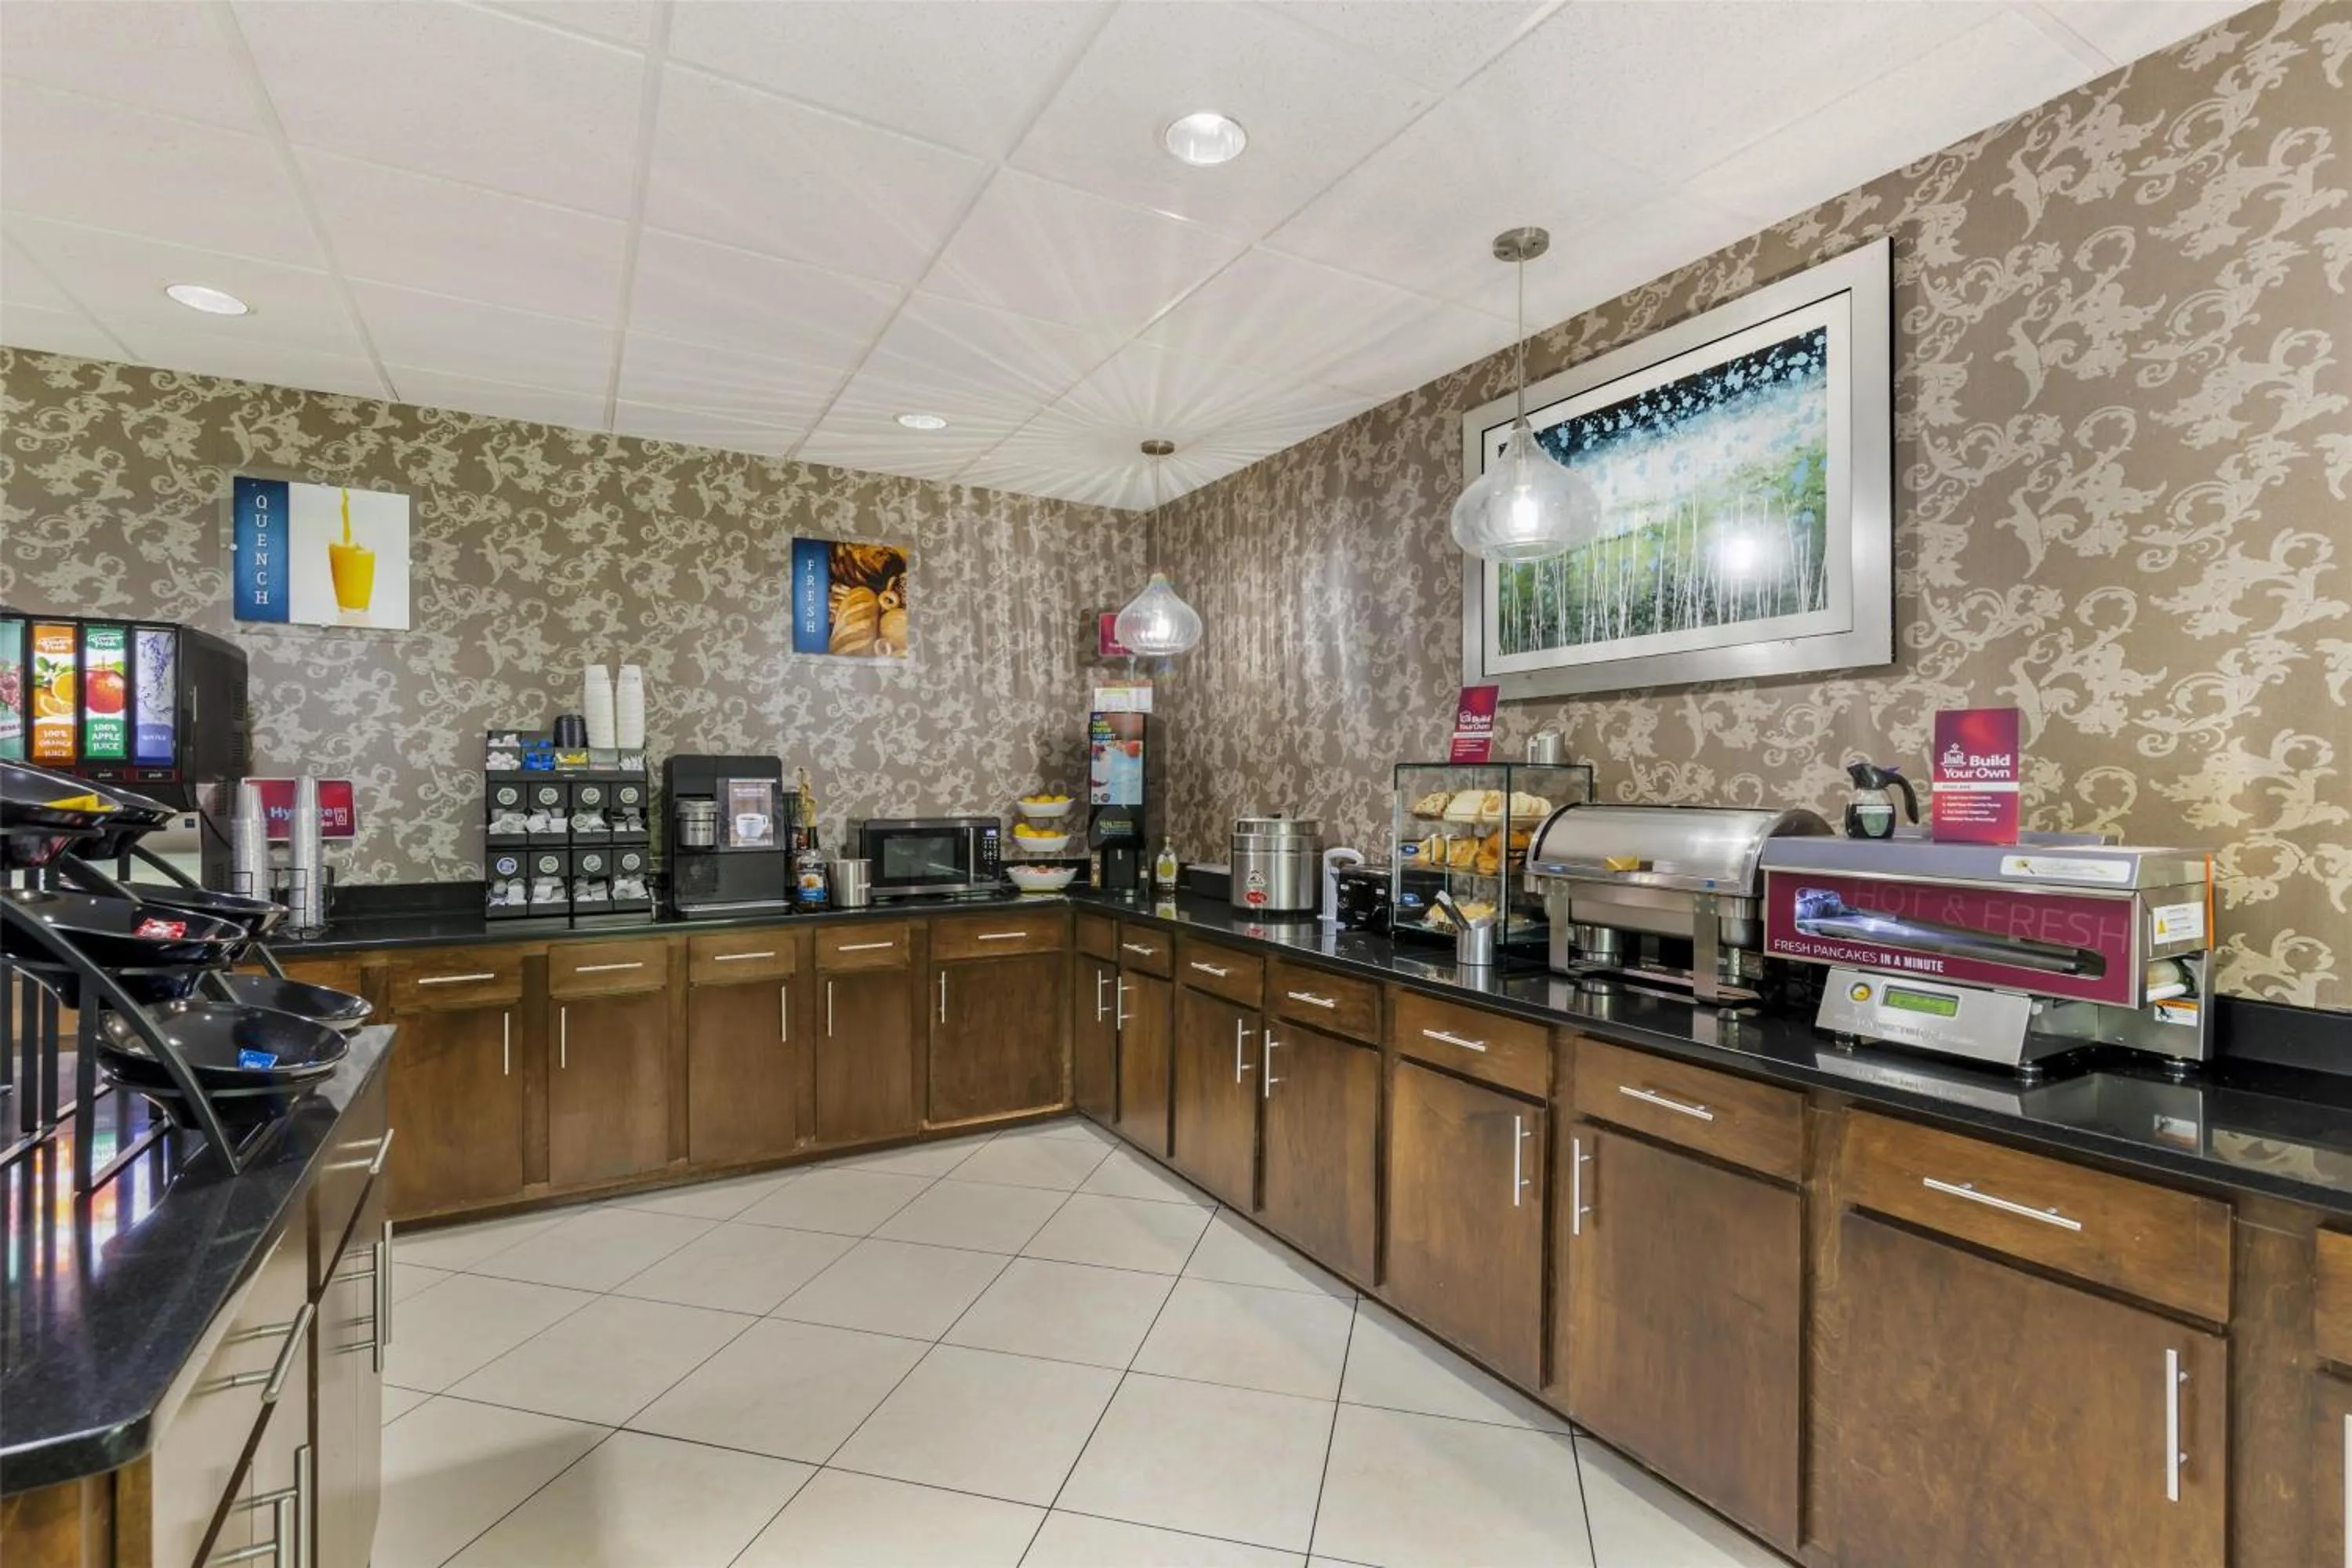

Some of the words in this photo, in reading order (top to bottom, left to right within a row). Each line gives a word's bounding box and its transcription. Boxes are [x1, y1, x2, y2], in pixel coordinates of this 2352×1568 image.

[255, 494, 269, 604] QUENCH
[806, 559, 815, 633] FRESH
[93, 742, 118, 751] JUICE
[1969, 754, 2011, 767] Build
[1944, 768, 1974, 779] Your
[1976, 768, 2011, 779] Own
[1853, 880, 1929, 917] HOT
[1983, 902, 2129, 954] FRESH
[1774, 939, 1810, 954] FRESH
[1813, 945, 1878, 964] PANCAKES
[1880, 953, 1892, 965] IN
[1893, 955, 1902, 967] A
[1904, 956, 1944, 973] MINUTE
